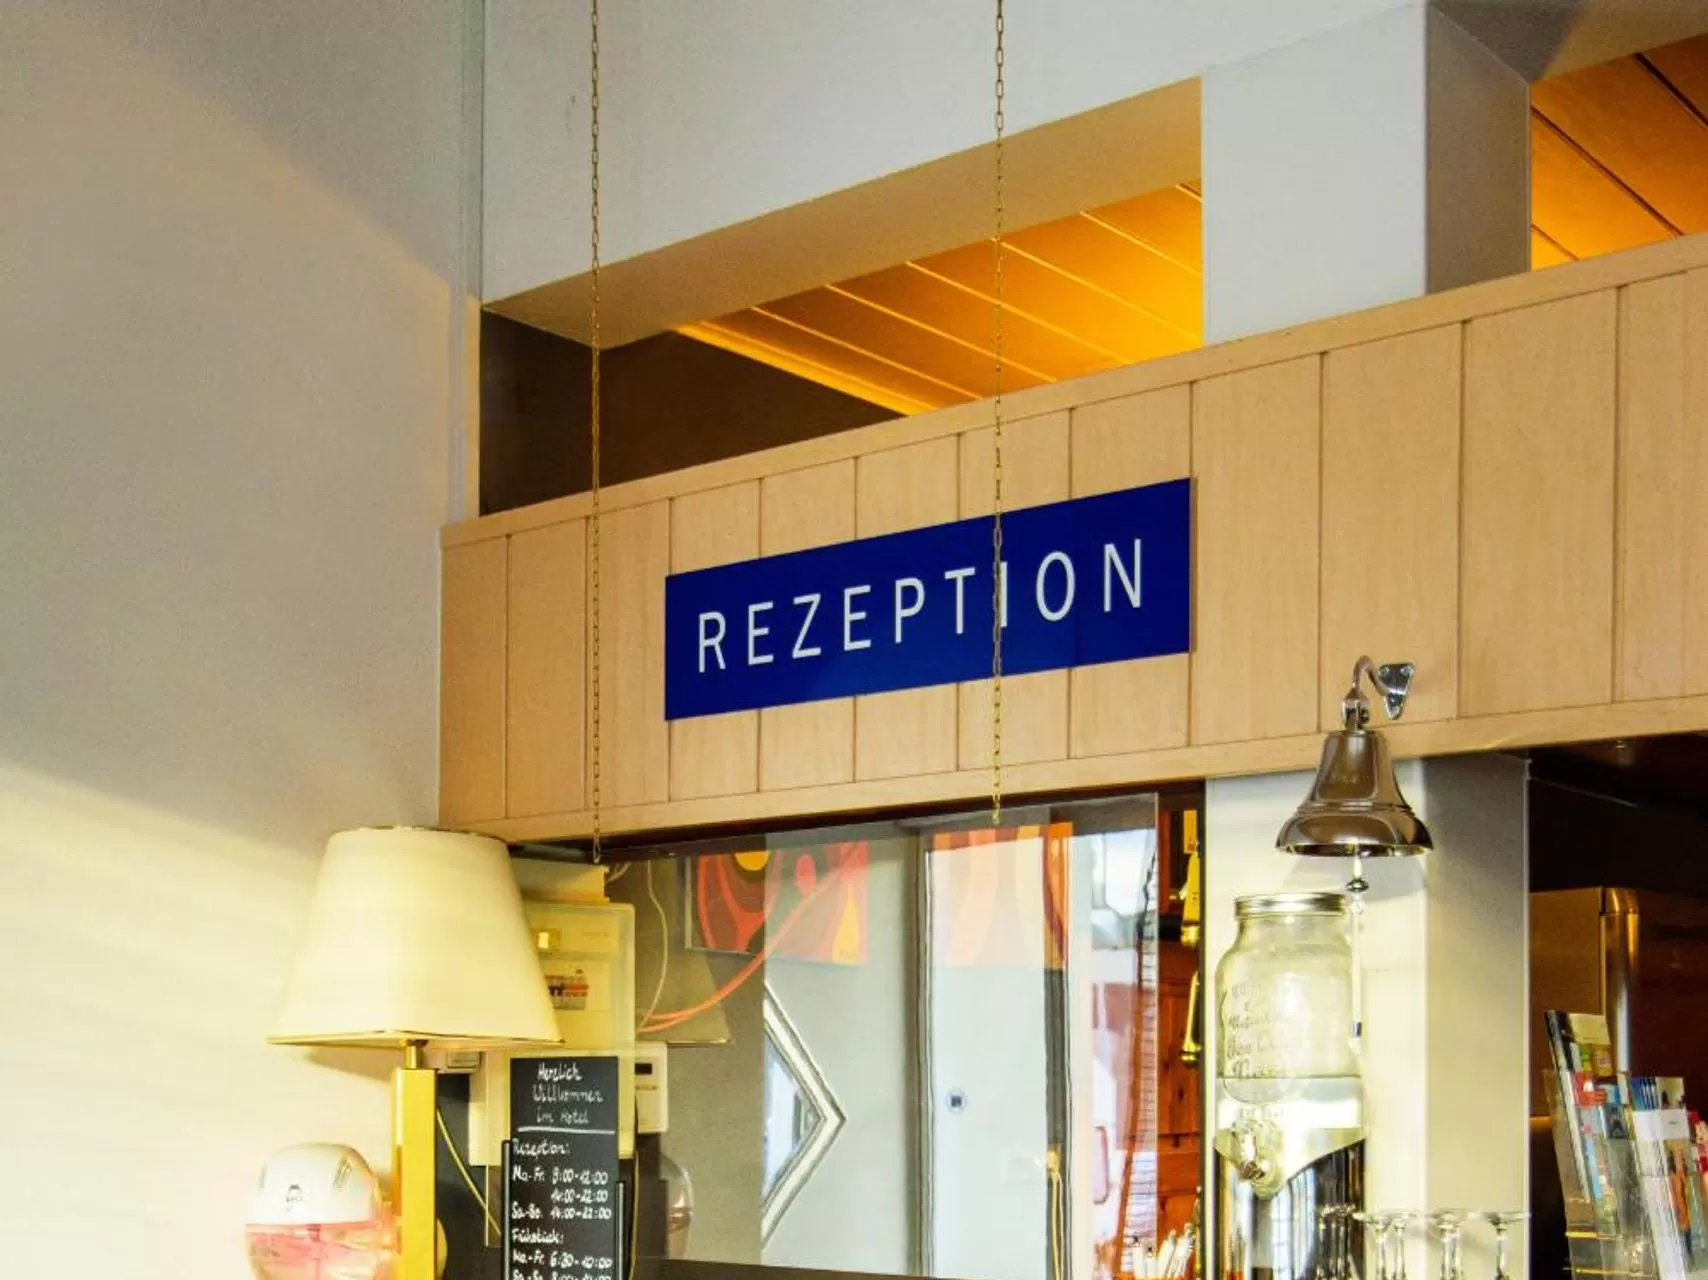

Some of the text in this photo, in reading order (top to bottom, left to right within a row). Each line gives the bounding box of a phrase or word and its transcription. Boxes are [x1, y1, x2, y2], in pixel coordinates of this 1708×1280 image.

[697, 537, 1142, 674] REZEPTION
[536, 1061, 583, 1082] Herzlich
[531, 1083, 604, 1103] Willkommen
[560, 1108, 590, 1126] Hotel
